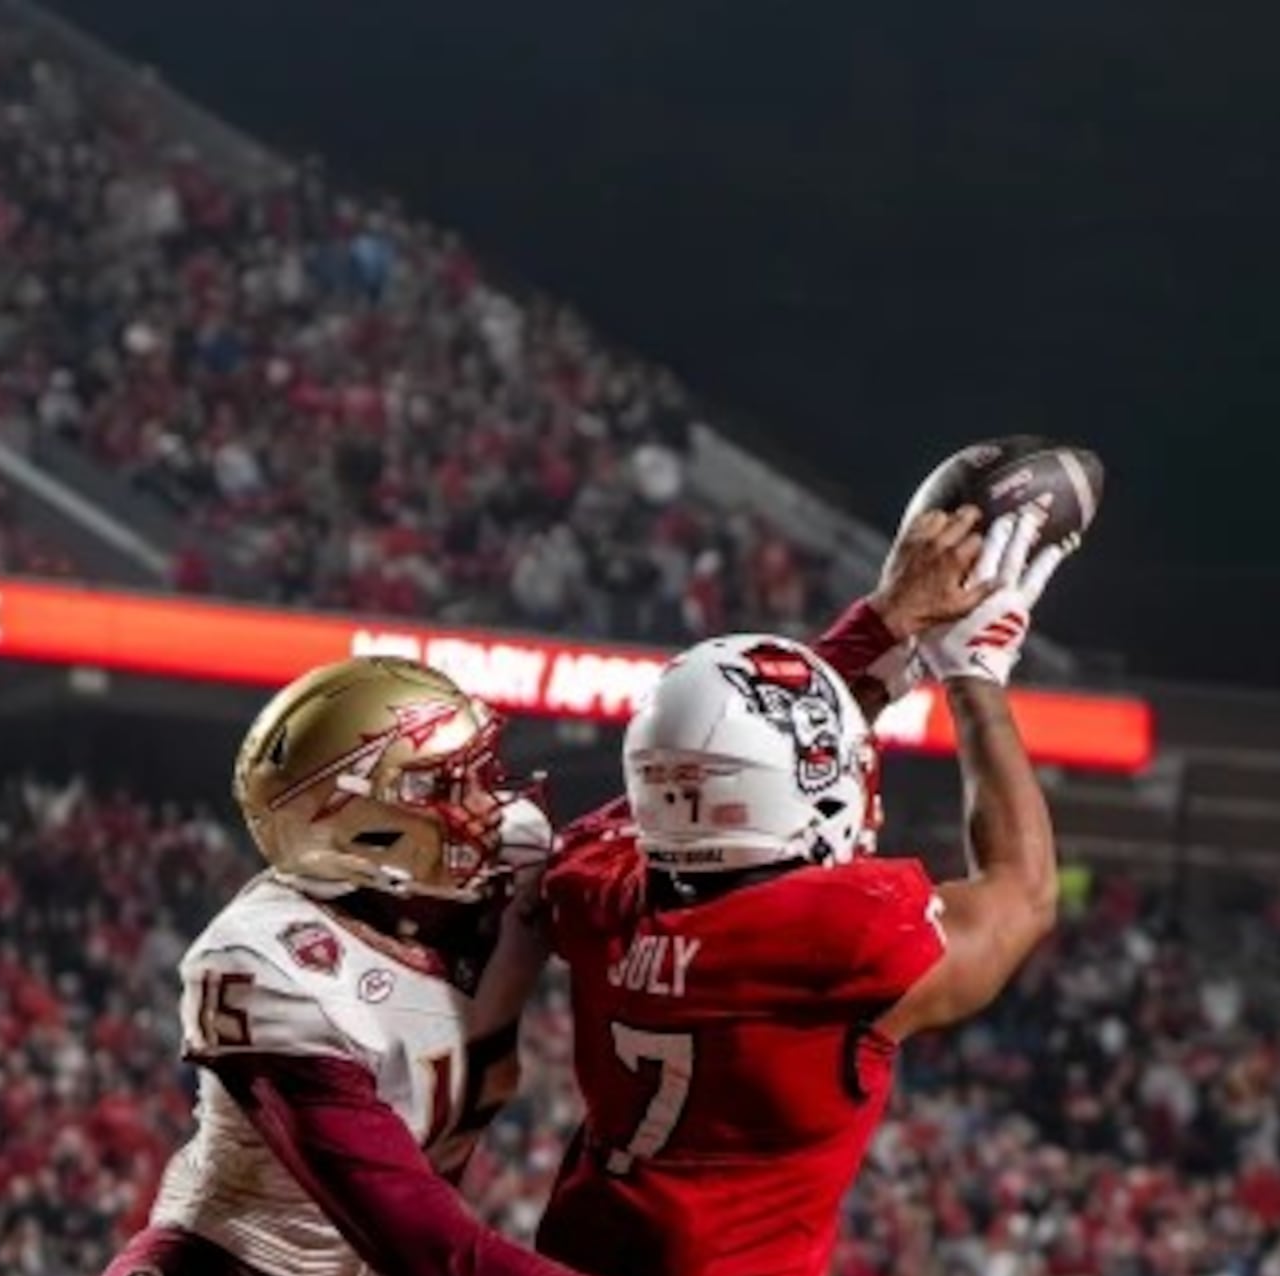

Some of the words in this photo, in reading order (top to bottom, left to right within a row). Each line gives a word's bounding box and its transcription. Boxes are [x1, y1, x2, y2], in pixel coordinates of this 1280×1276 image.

[682, 787, 701, 823] 7
[197, 968, 256, 1049] 15
[606, 1021, 694, 1175] 7
